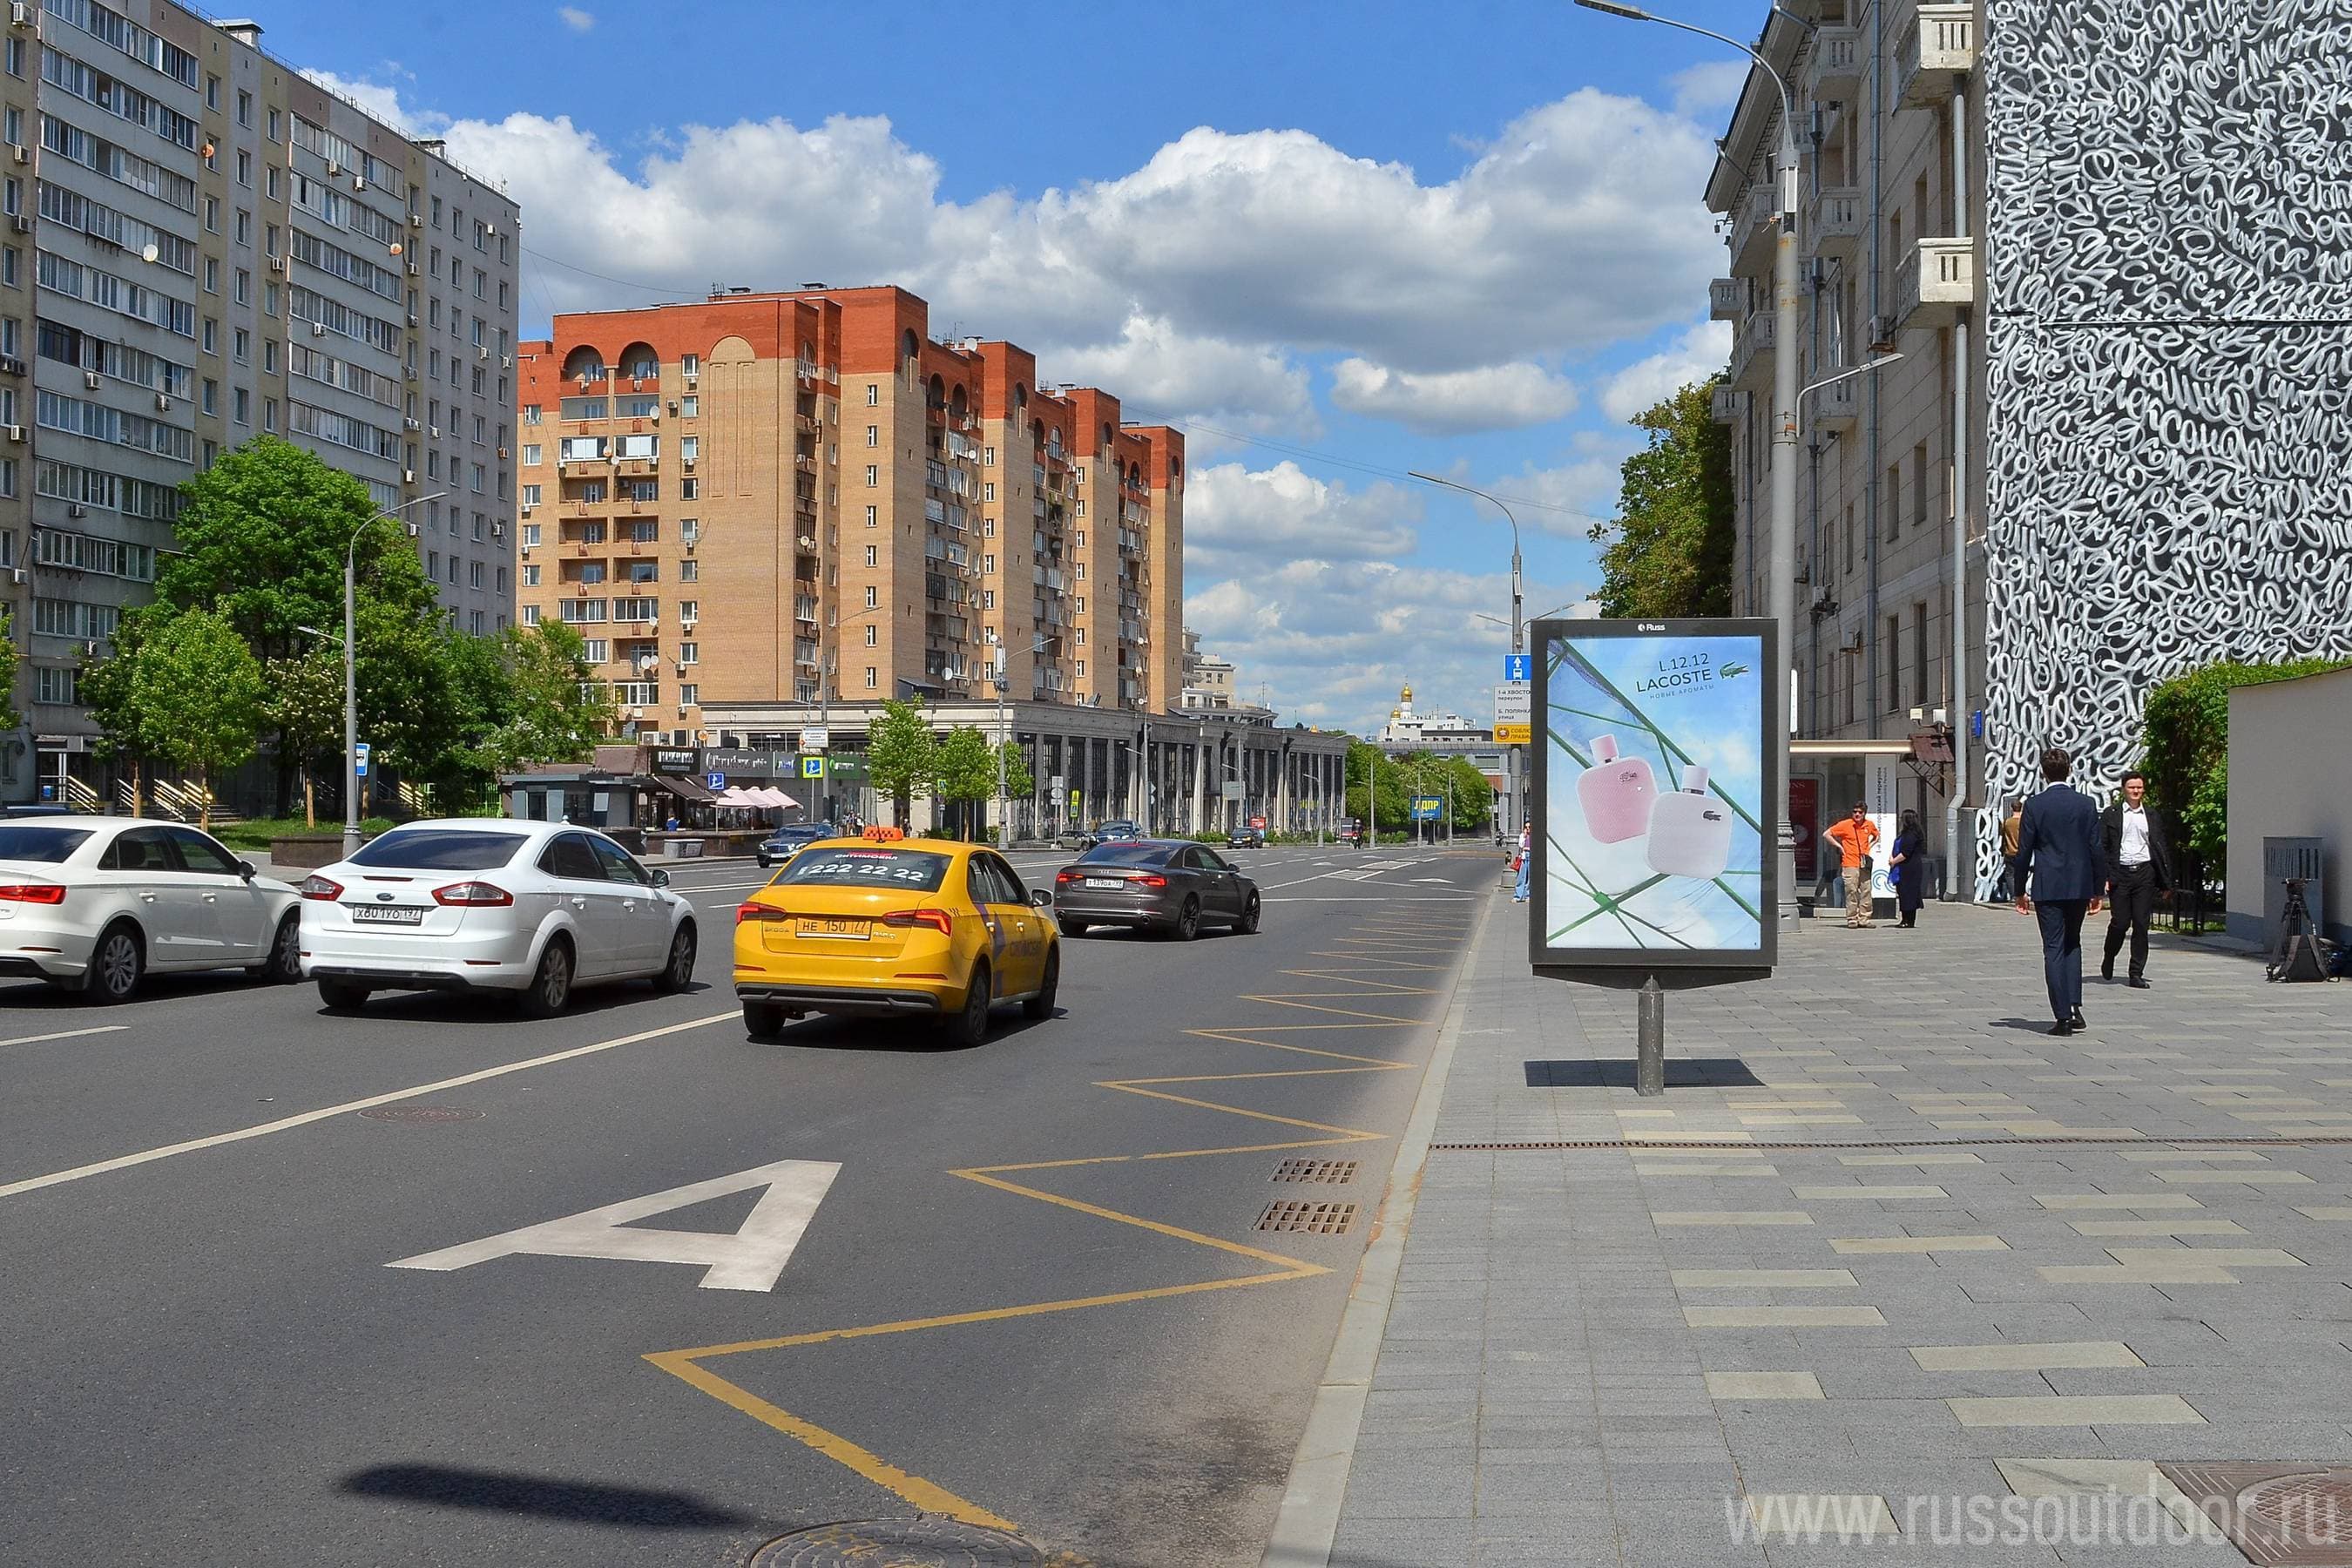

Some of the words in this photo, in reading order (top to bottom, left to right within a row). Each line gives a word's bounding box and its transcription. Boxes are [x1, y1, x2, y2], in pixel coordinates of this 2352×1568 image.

[1659, 652, 1710, 672] L.12.12
[1636, 668, 1713, 693] LACOSTE
[1650, 691, 1675, 700] НОВЫЕ
[1679, 684, 1715, 694] АРОМАТЫ
[1414, 800, 1439, 812] ЛДПР
[808, 864, 853, 874] 222
[857, 865, 889, 875] 22
[893, 868, 924, 882] 22
[802, 921, 818, 931] НЕ
[824, 920, 847, 932] 150
[855, 920, 867, 930] 77
